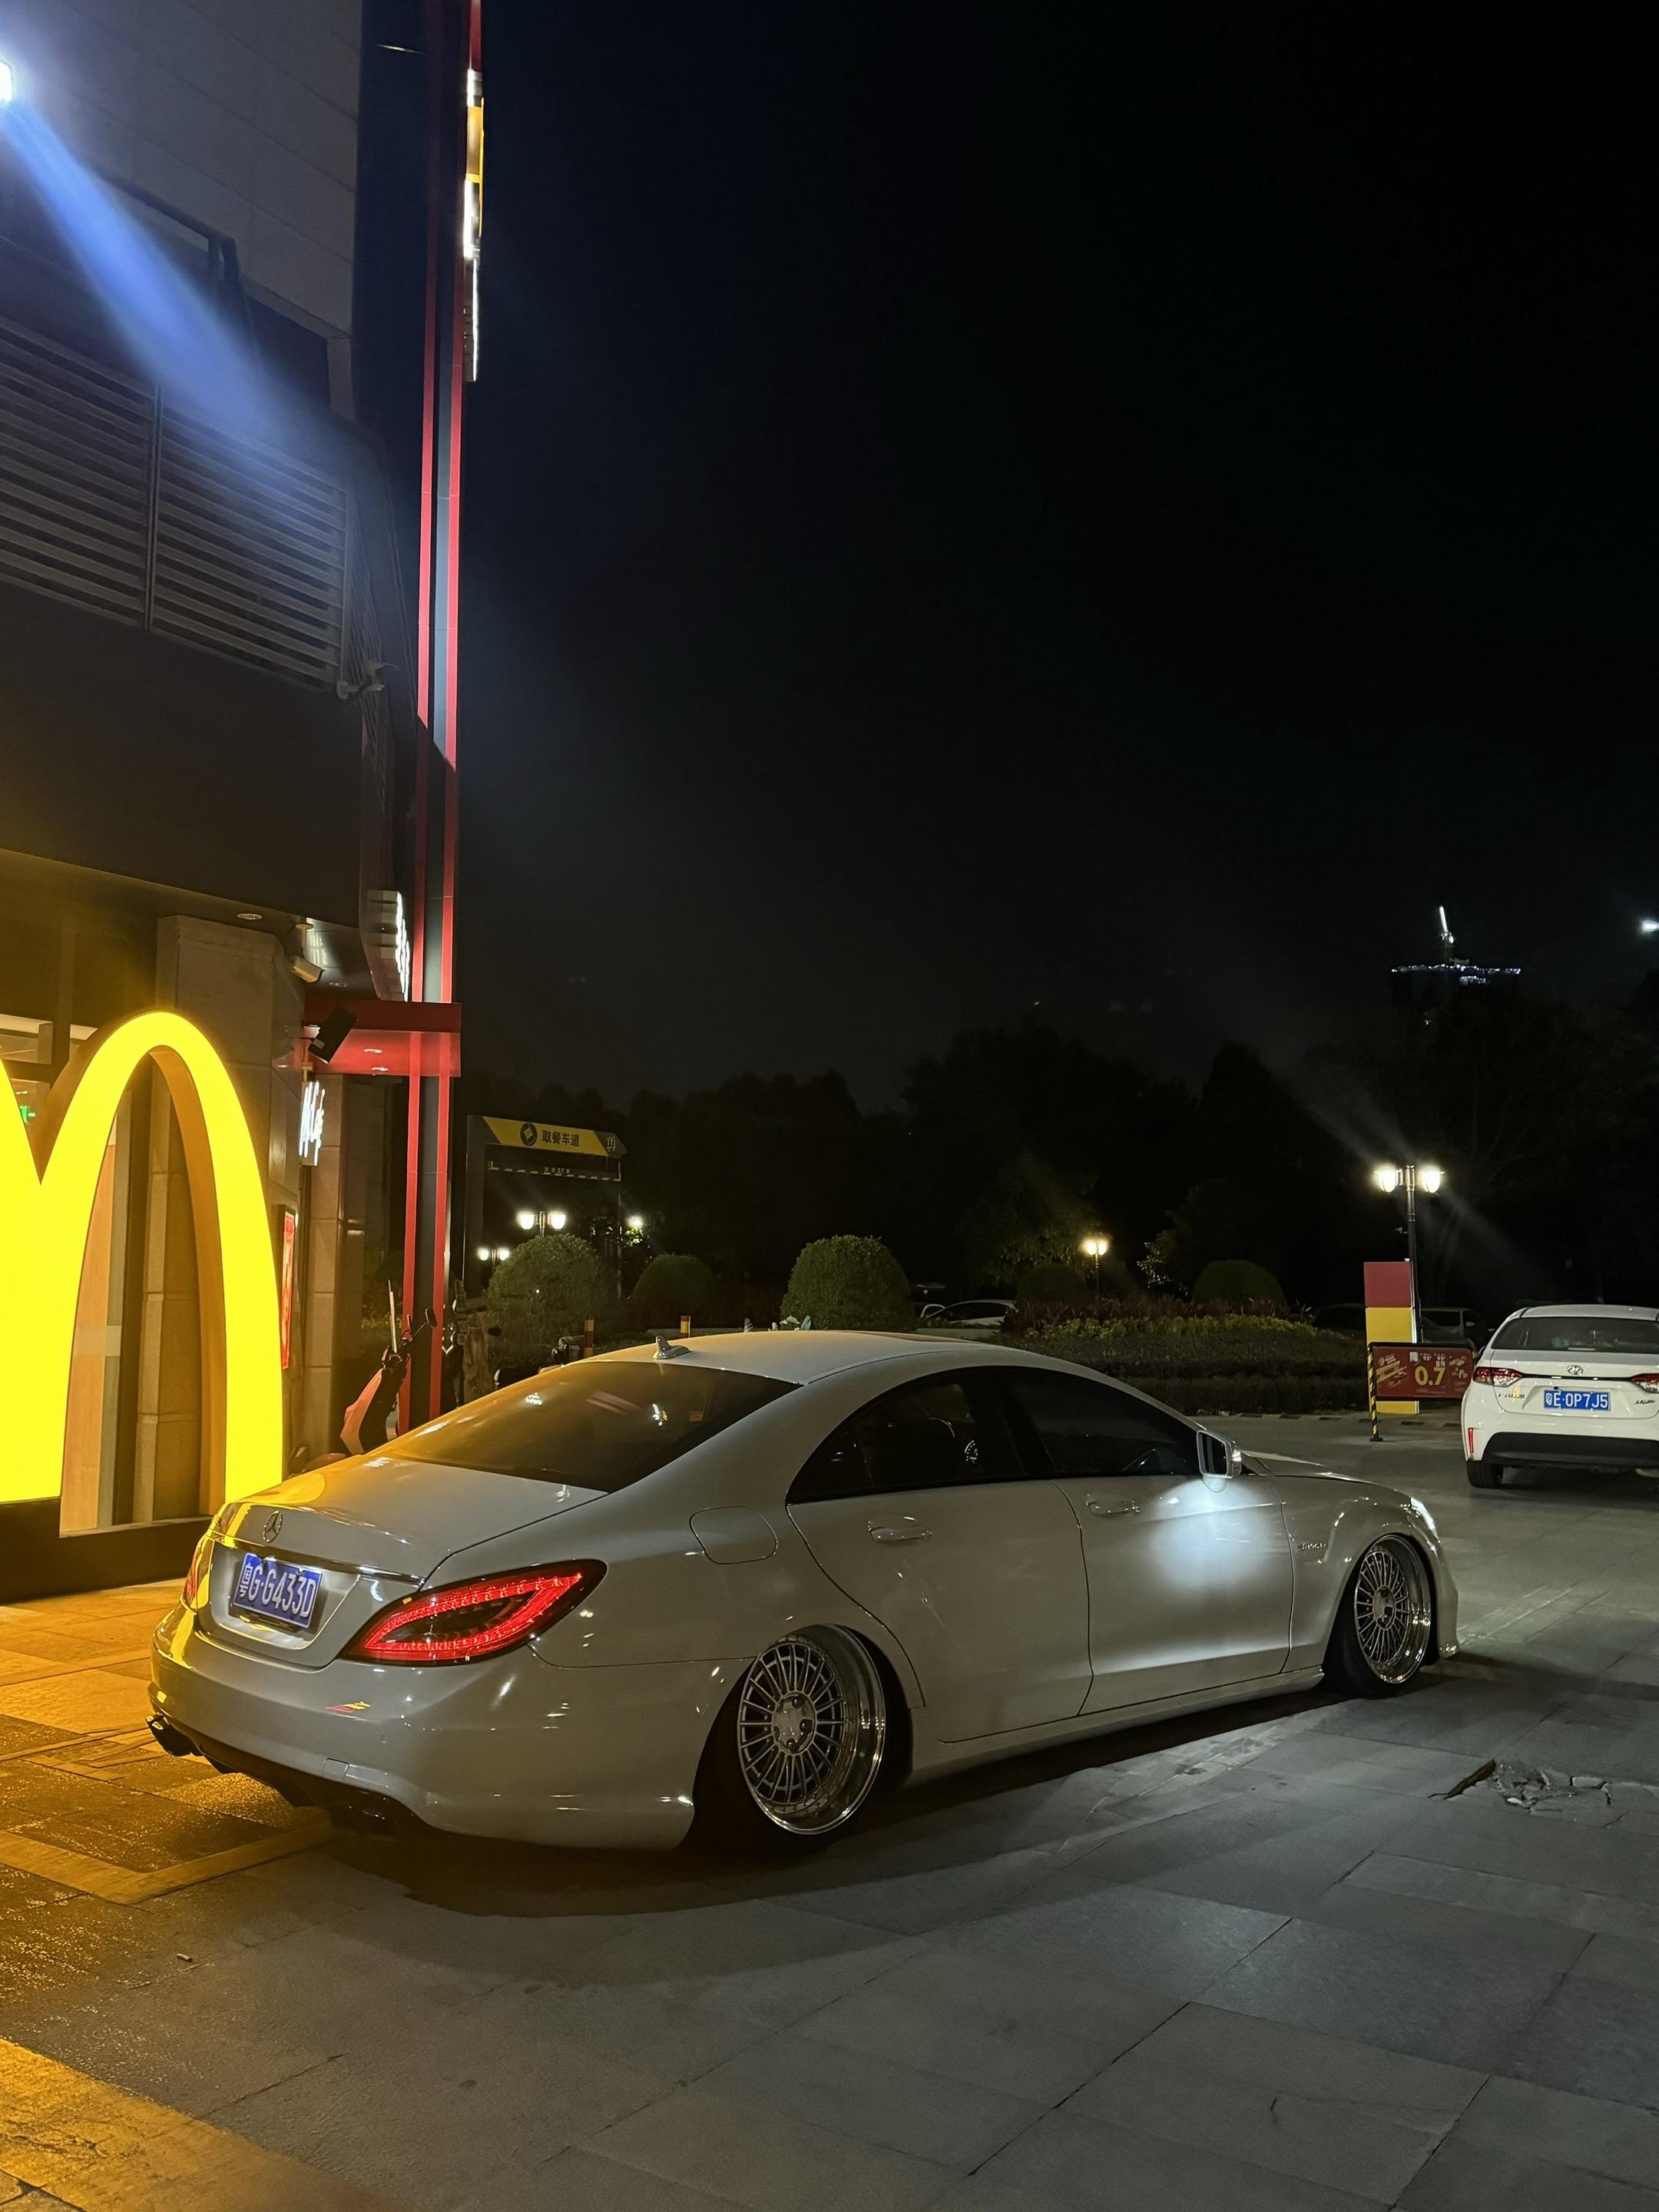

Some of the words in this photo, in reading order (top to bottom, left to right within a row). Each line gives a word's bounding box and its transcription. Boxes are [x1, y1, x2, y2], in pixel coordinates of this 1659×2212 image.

[542, 1131, 579, 1147] 取餐车道
[1415, 1365, 1445, 1386] 0.7
